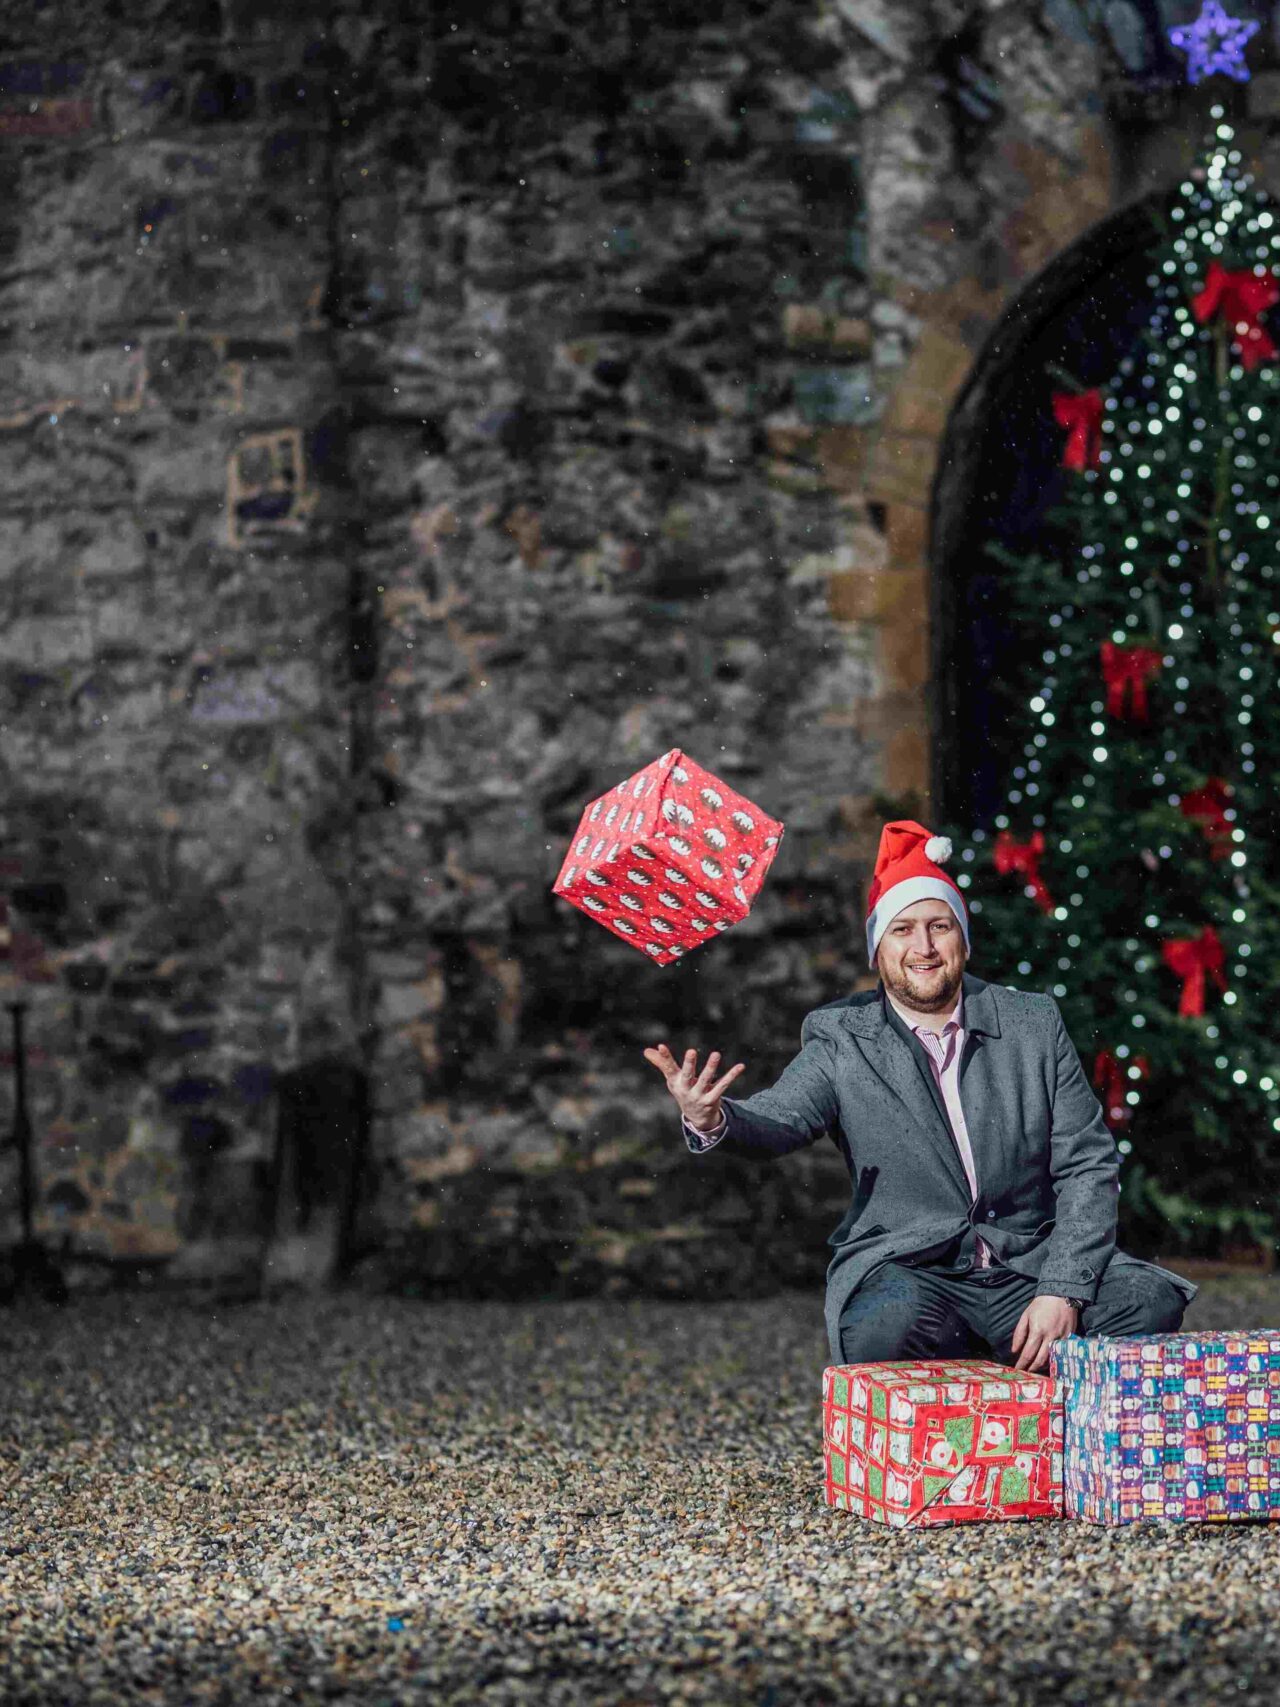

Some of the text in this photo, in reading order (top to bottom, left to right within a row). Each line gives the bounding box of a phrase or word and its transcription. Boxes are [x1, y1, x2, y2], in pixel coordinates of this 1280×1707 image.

[1120, 1348, 1140, 1500] H H H H H
[1143, 1364, 1164, 1515] H H H H H
[1164, 1344, 1184, 1496] H H H H H
[1185, 1361, 1204, 1515] H H H H H
[1205, 1409, 1224, 1421] H
[1207, 1376, 1227, 1389] H
[1208, 1445, 1226, 1458] H
[1226, 1357, 1246, 1508] H H H H H
[1248, 1342, 1268, 1490] H H H H H
[1206, 1478, 1224, 1490] H
